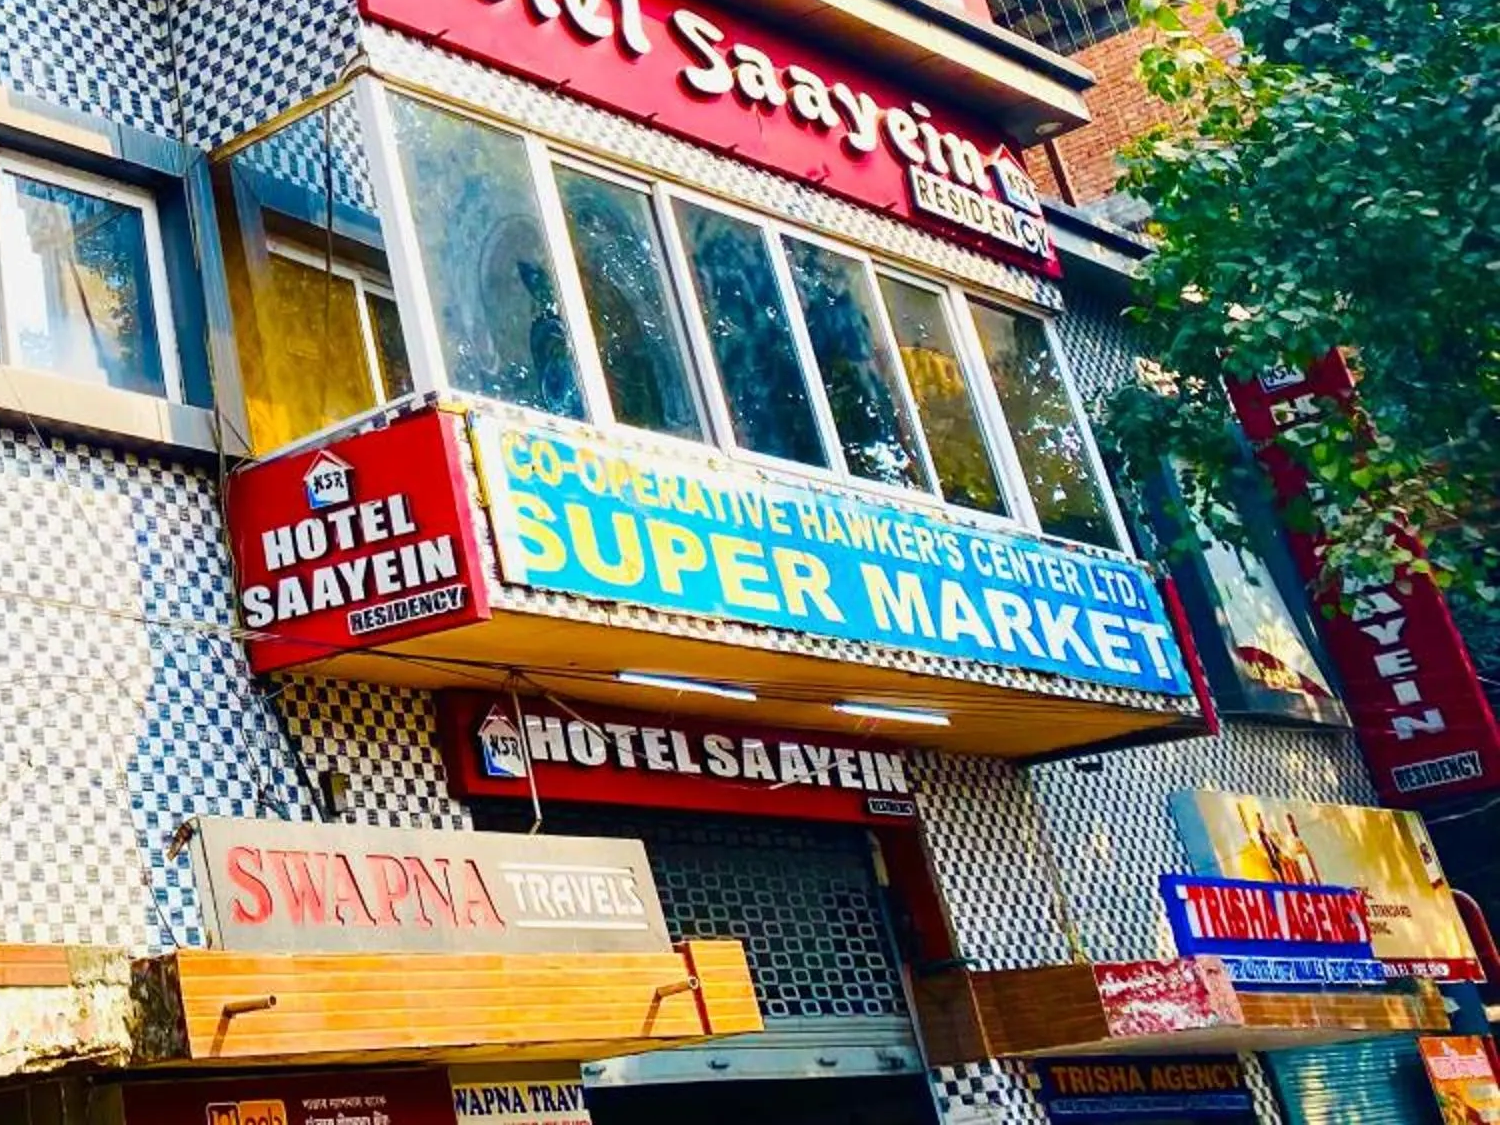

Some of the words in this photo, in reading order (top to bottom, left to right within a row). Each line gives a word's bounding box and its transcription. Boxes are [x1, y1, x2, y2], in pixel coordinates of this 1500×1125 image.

[670, 5, 994, 193] Saayein
[916, 174, 1048, 259] RESIDENCY
[261, 493, 417, 571] HOTEL
[501, 429, 791, 537] CO-OPERATIVE
[798, 499, 961, 574] HAWKER'S
[970, 540, 1080, 597] CENTER
[242, 534, 459, 630] SAAYEIN
[349, 588, 464, 633] RESIDENCY
[505, 489, 847, 625] SUPER
[869, 562, 1174, 682] MARKET
[523, 713, 700, 775] HOTEL
[707, 734, 908, 795] SAAYEIN
[226, 845, 507, 933] SWAPNA
[505, 871, 645, 918] TRAVELS
[1178, 884, 1281, 940] TRISHA
[1278, 888, 1373, 944] AGENCY
[1051, 1064, 1146, 1094] TRISHA
[1150, 1063, 1241, 1092] AGENCY
